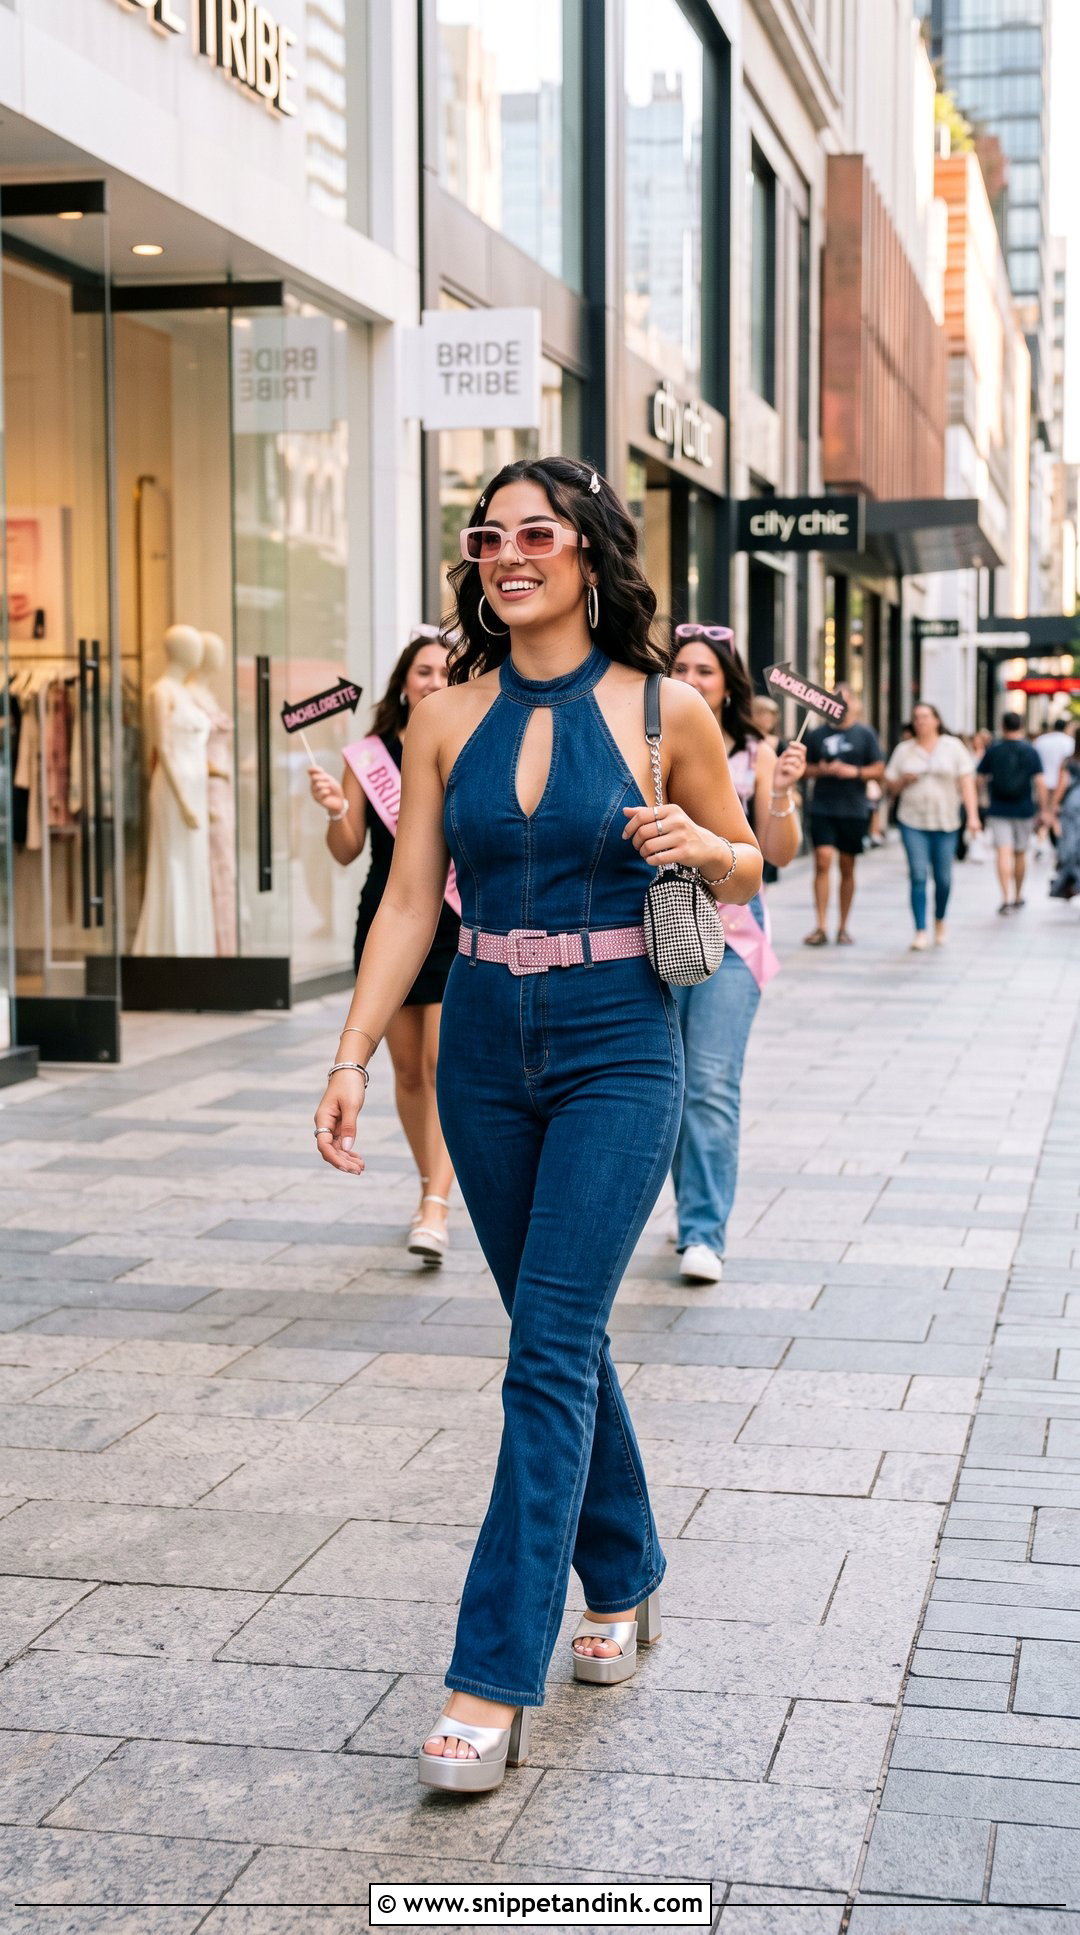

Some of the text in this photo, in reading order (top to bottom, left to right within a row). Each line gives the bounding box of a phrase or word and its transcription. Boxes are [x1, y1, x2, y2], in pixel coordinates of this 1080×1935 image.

[437, 340, 521, 367] BRIDE
[439, 370, 521, 396] TRIBE
[749, 508, 850, 542] city chic
[283, 685, 358, 729] BACHELORETTE
[769, 667, 845, 720] BACHELORETTE
[366, 765, 401, 825] BRID
